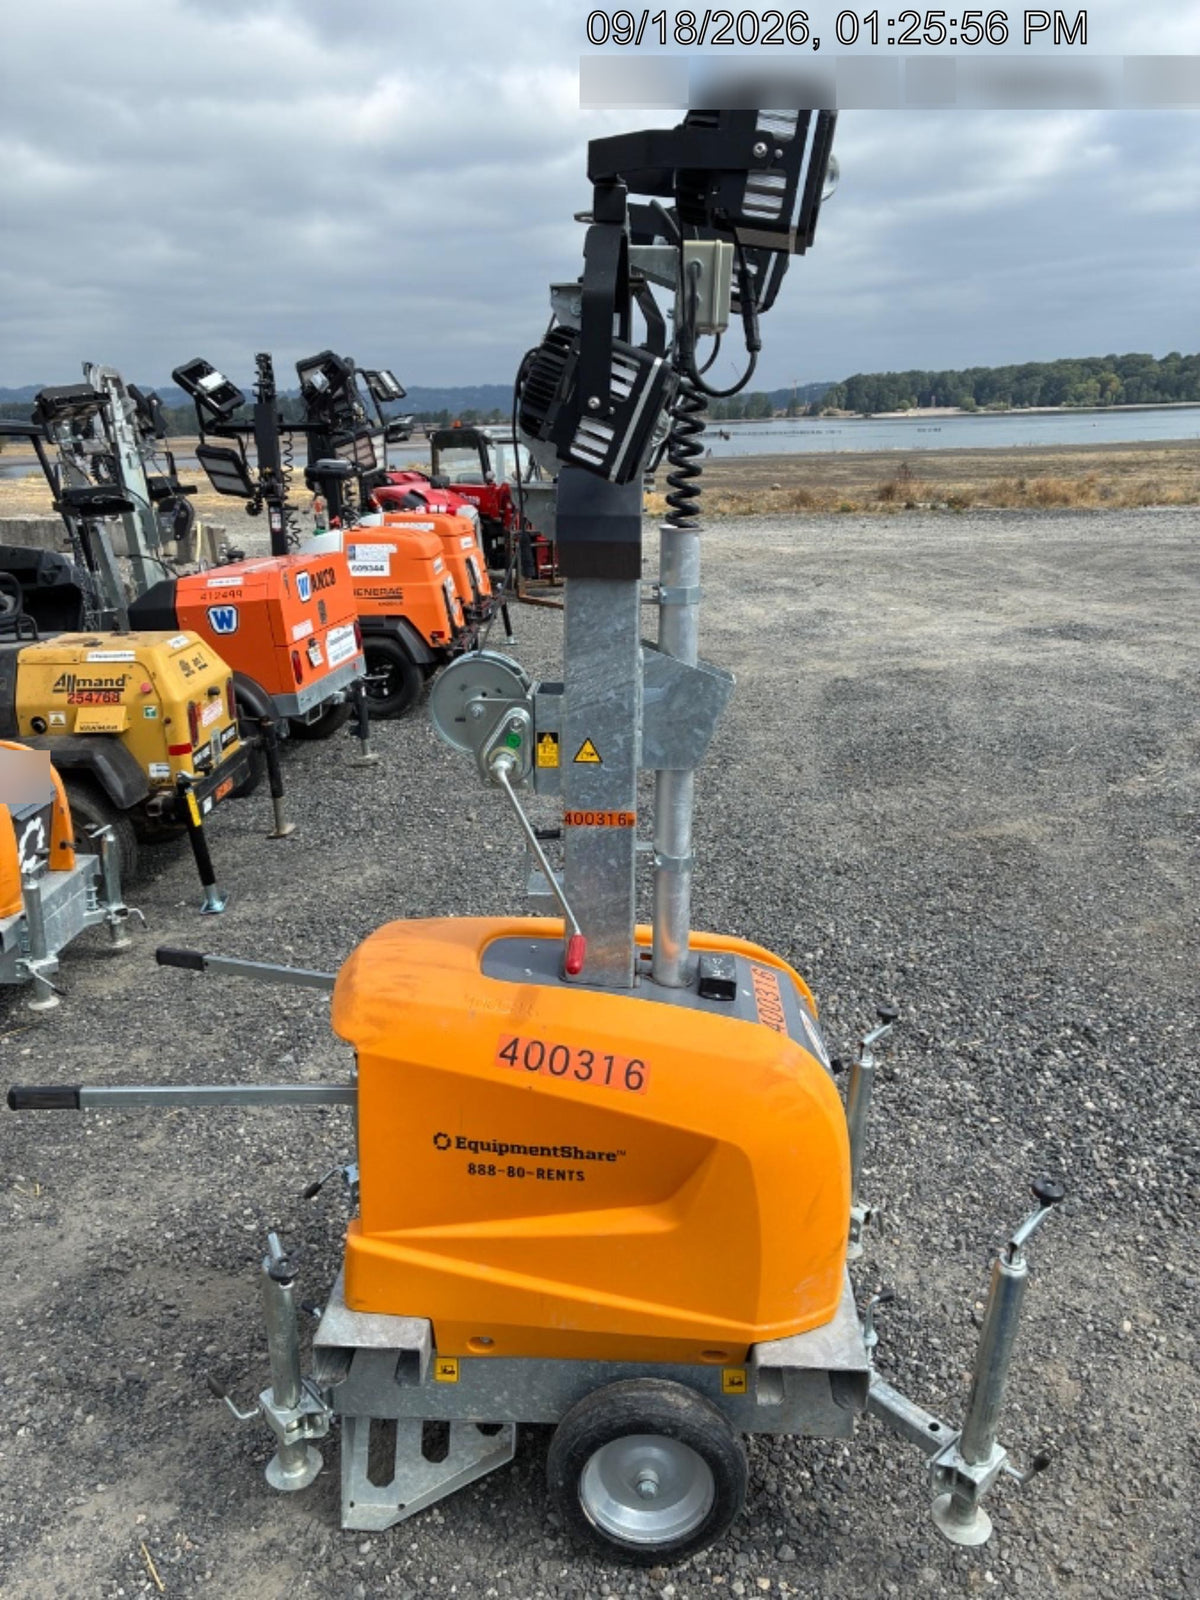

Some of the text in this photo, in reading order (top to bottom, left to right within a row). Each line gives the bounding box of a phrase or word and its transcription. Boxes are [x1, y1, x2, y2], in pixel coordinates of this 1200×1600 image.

[200, 589, 243, 600] 412499
[54, 673, 126, 692] Allmand
[564, 812, 627, 826] 400316
[499, 1036, 645, 1091] 400316
[468, 1162, 585, 1182] 888-80-RENTS
